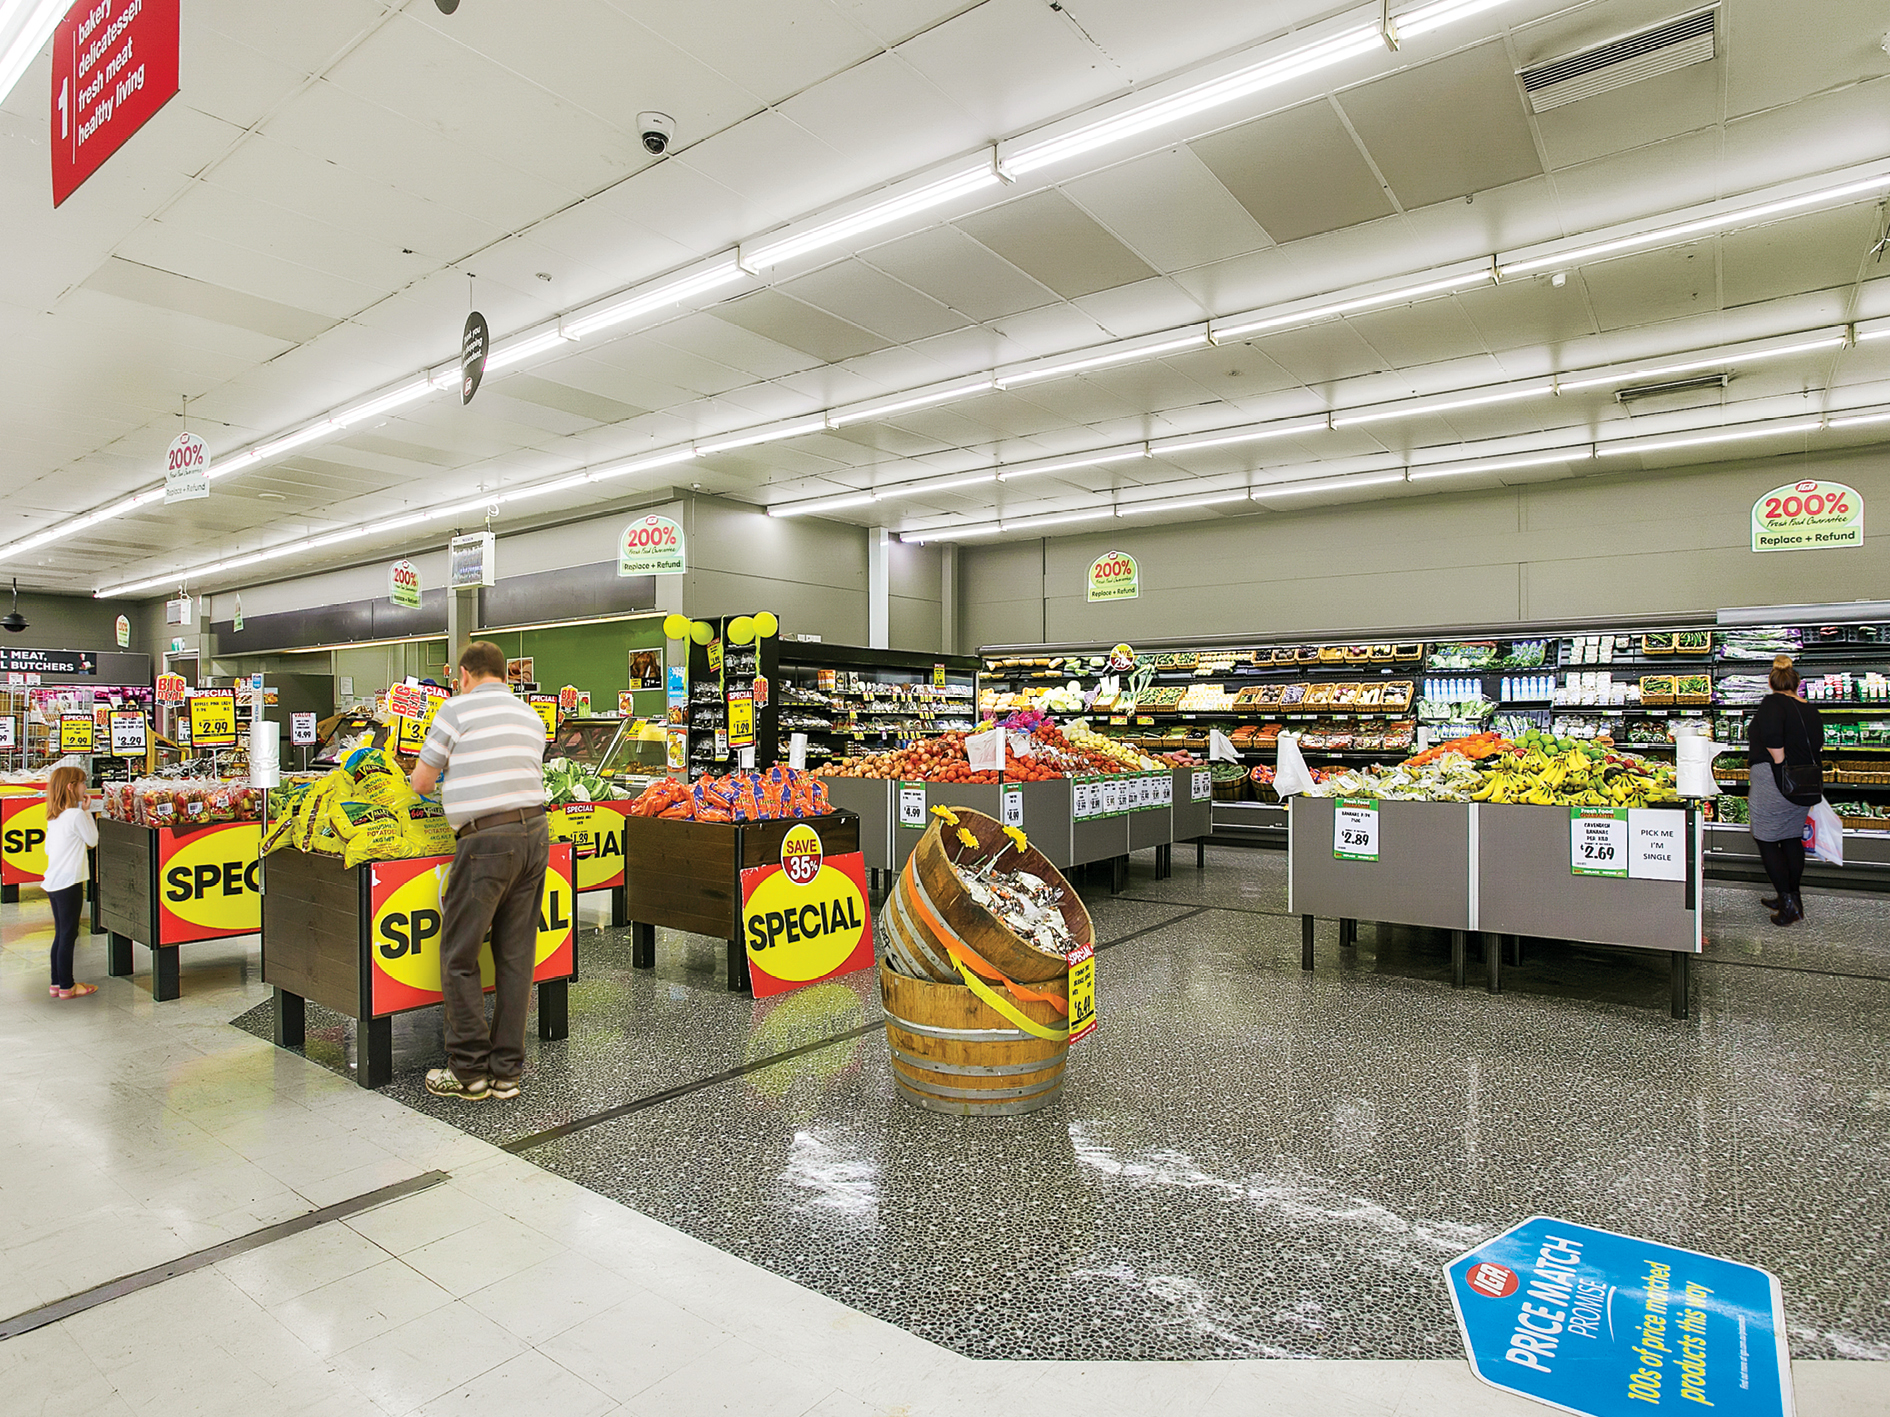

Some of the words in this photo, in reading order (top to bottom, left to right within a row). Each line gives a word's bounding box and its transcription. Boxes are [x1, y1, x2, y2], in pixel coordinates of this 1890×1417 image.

[78, 0, 111, 46] bakery
[78, 0, 142, 79] delicatessen
[78, 70, 104, 113] fresh
[105, 36, 133, 83] meat
[57, 75, 70, 140] 1
[78, 95, 114, 147] healthy
[115, 63, 145, 108] living
[169, 444, 203, 471] 200%
[1797, 482, 1816, 492] IGA
[1765, 492, 1849, 519] 200%
[1767, 519, 1787, 528] Fresh
[1789, 517, 1804, 527] Food
[1807, 515, 1848, 526] Guarantee
[628, 526, 676, 548] 200%
[1760, 536, 1802, 546] Replace
[1815, 531, 1855, 541] Refund
[624, 562, 649, 572] Replace
[657, 560, 681, 569] Refund
[1095, 560, 1131, 578] 200%
[394, 568, 417, 587] 200%
[10, 651, 47, 662] MEAT,
[10, 661, 74, 671] BUTCHERS
[157, 690, 184, 701] DEAL
[158, 678, 184, 692] BIG
[193, 689, 234, 697] SPECIAL
[729, 691, 752, 700] SPECIAL
[754, 681, 768, 693] BIG
[392, 685, 411, 715] BIG
[406, 690, 421, 718] DEAL
[199, 722, 228, 734] $2.99
[566, 805, 594, 814] SPECIAL
[570, 833, 588, 844] $1.39
[1341, 831, 1369, 846] $2.89
[1641, 829, 1659, 837] PICK
[1661, 830, 1674, 838] ME
[786, 839, 817, 854] SAVE
[1580, 845, 1615, 860] $2.69
[1643, 853, 1672, 861] SINGLE
[790, 855, 818, 880] 35%
[167, 860, 260, 902] SPEC
[748, 896, 862, 952] SPECIAL
[1068, 945, 1093, 966] SPECIAL
[1473, 1263, 1511, 1297] IGA
[1526, 1234, 1584, 1308] MATCH
[1640, 1259, 1671, 1315] matched
[1684, 1280, 1715, 1308] way
[1567, 1278, 1607, 1340] PROMISE
[1675, 1308, 1707, 1335] this
[1505, 1301, 1566, 1374] PRICE
[1634, 1314, 1673, 1353] price
[1631, 1346, 1664, 1368] of
[1672, 1334, 1715, 1407] products
[1627, 1367, 1662, 1405] 100s
